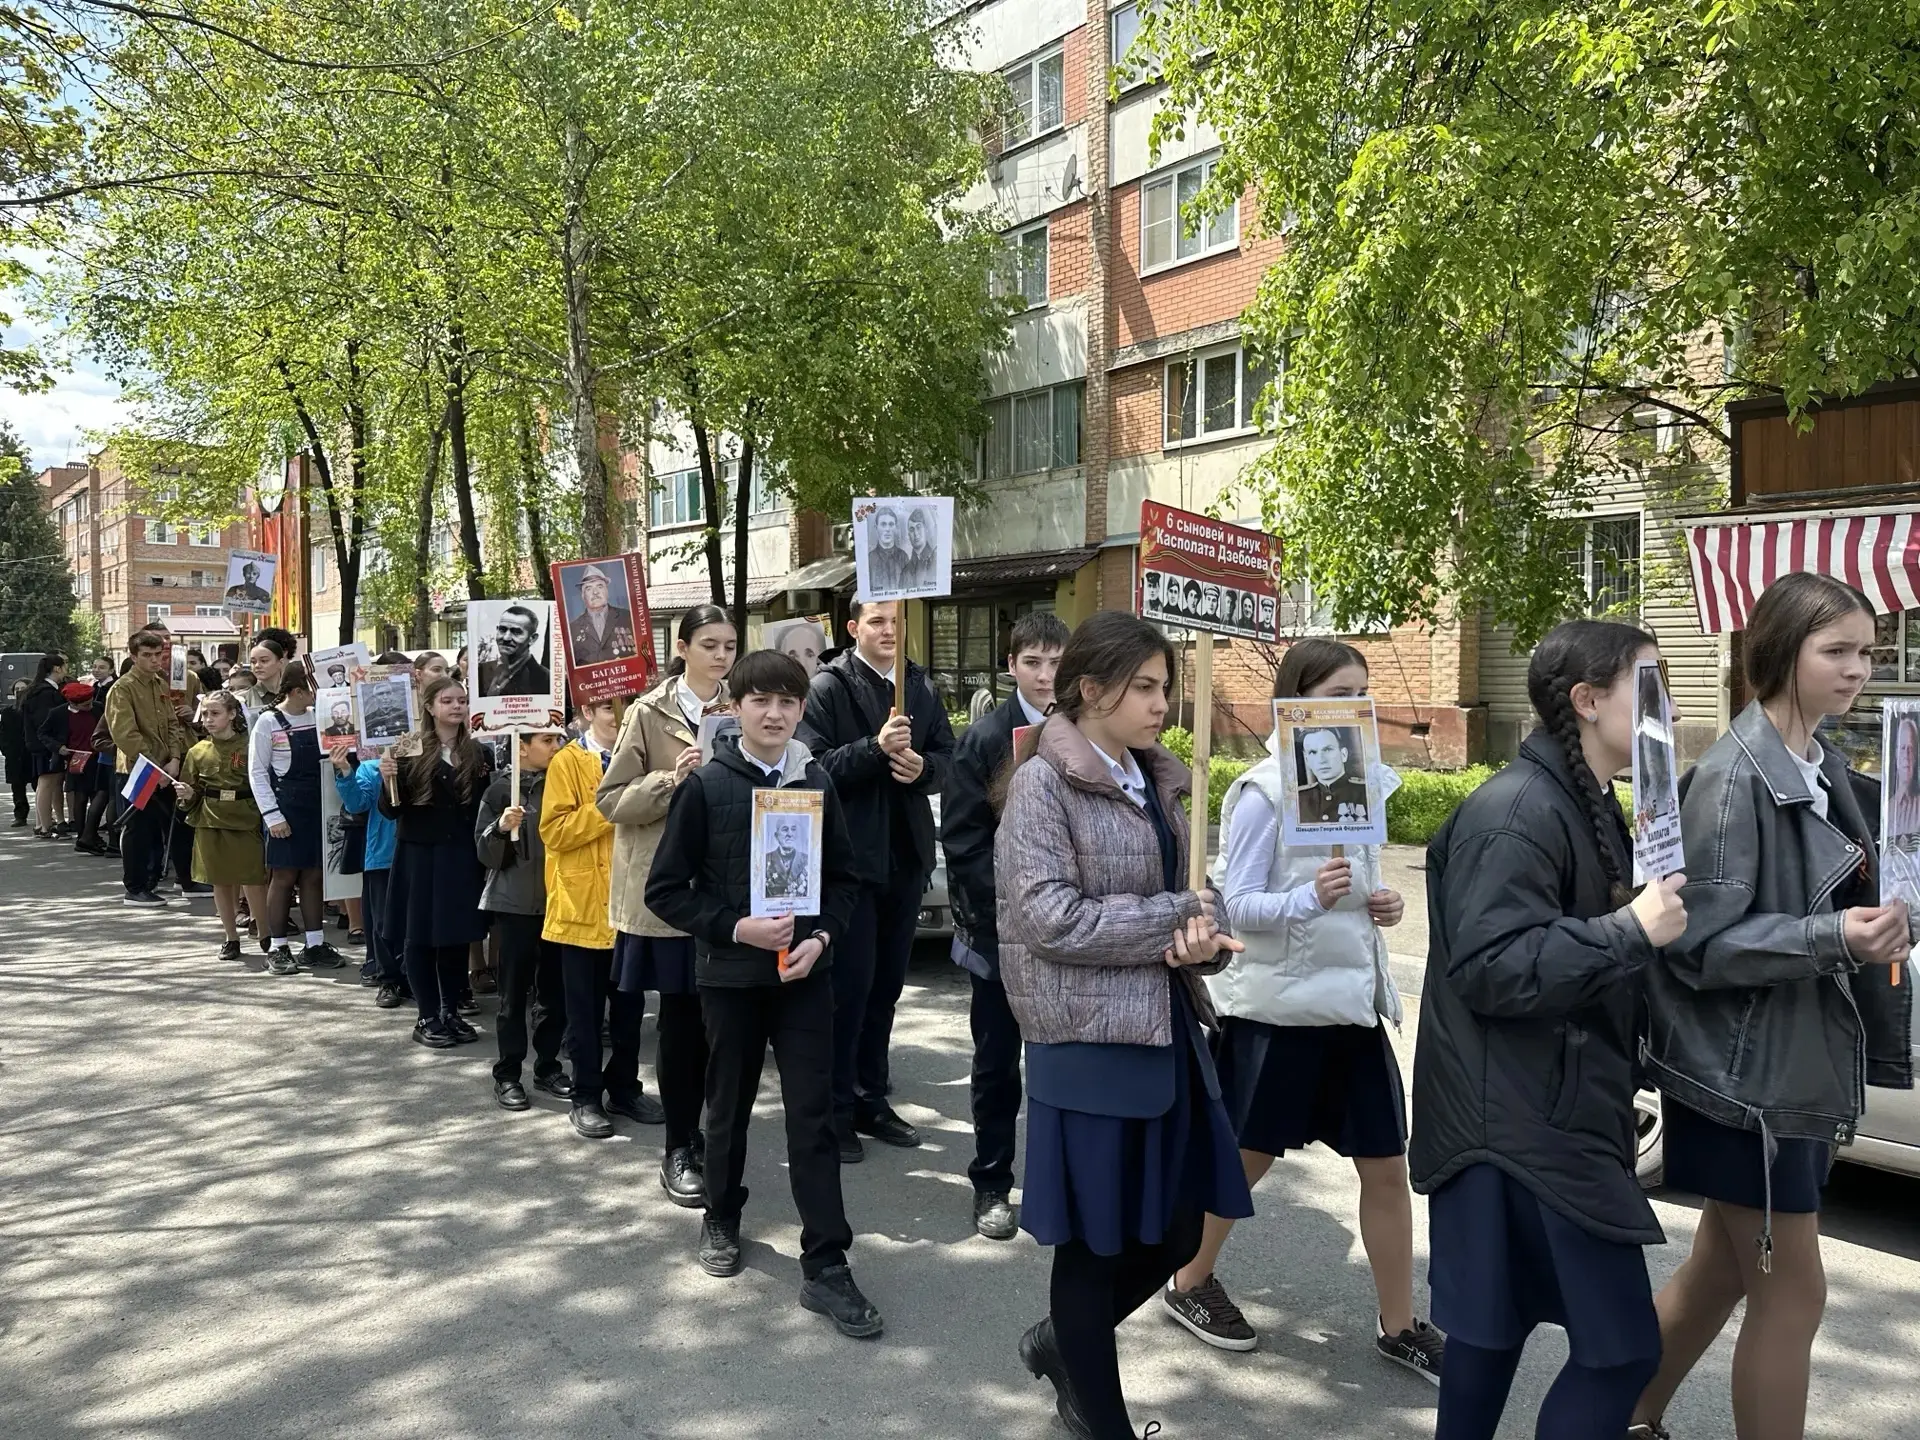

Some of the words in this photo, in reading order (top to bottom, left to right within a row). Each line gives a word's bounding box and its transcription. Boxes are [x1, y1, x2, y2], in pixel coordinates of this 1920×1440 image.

[1156, 528, 1215, 558] Касполата
[1218, 545, 1268, 570] Дзебоева
[1166, 512, 1174, 529] 6
[1176, 519, 1224, 542] сыновей
[1227, 532, 1234, 545] и
[1237, 536, 1260, 553] внук
[632, 578, 647, 635] БЕССМЕРТНЫЙ
[553, 634, 563, 707] БЕССМЕРТНЫЙ
[578, 679, 606, 691] Сослан
[591, 664, 627, 679] БАГАЕВ
